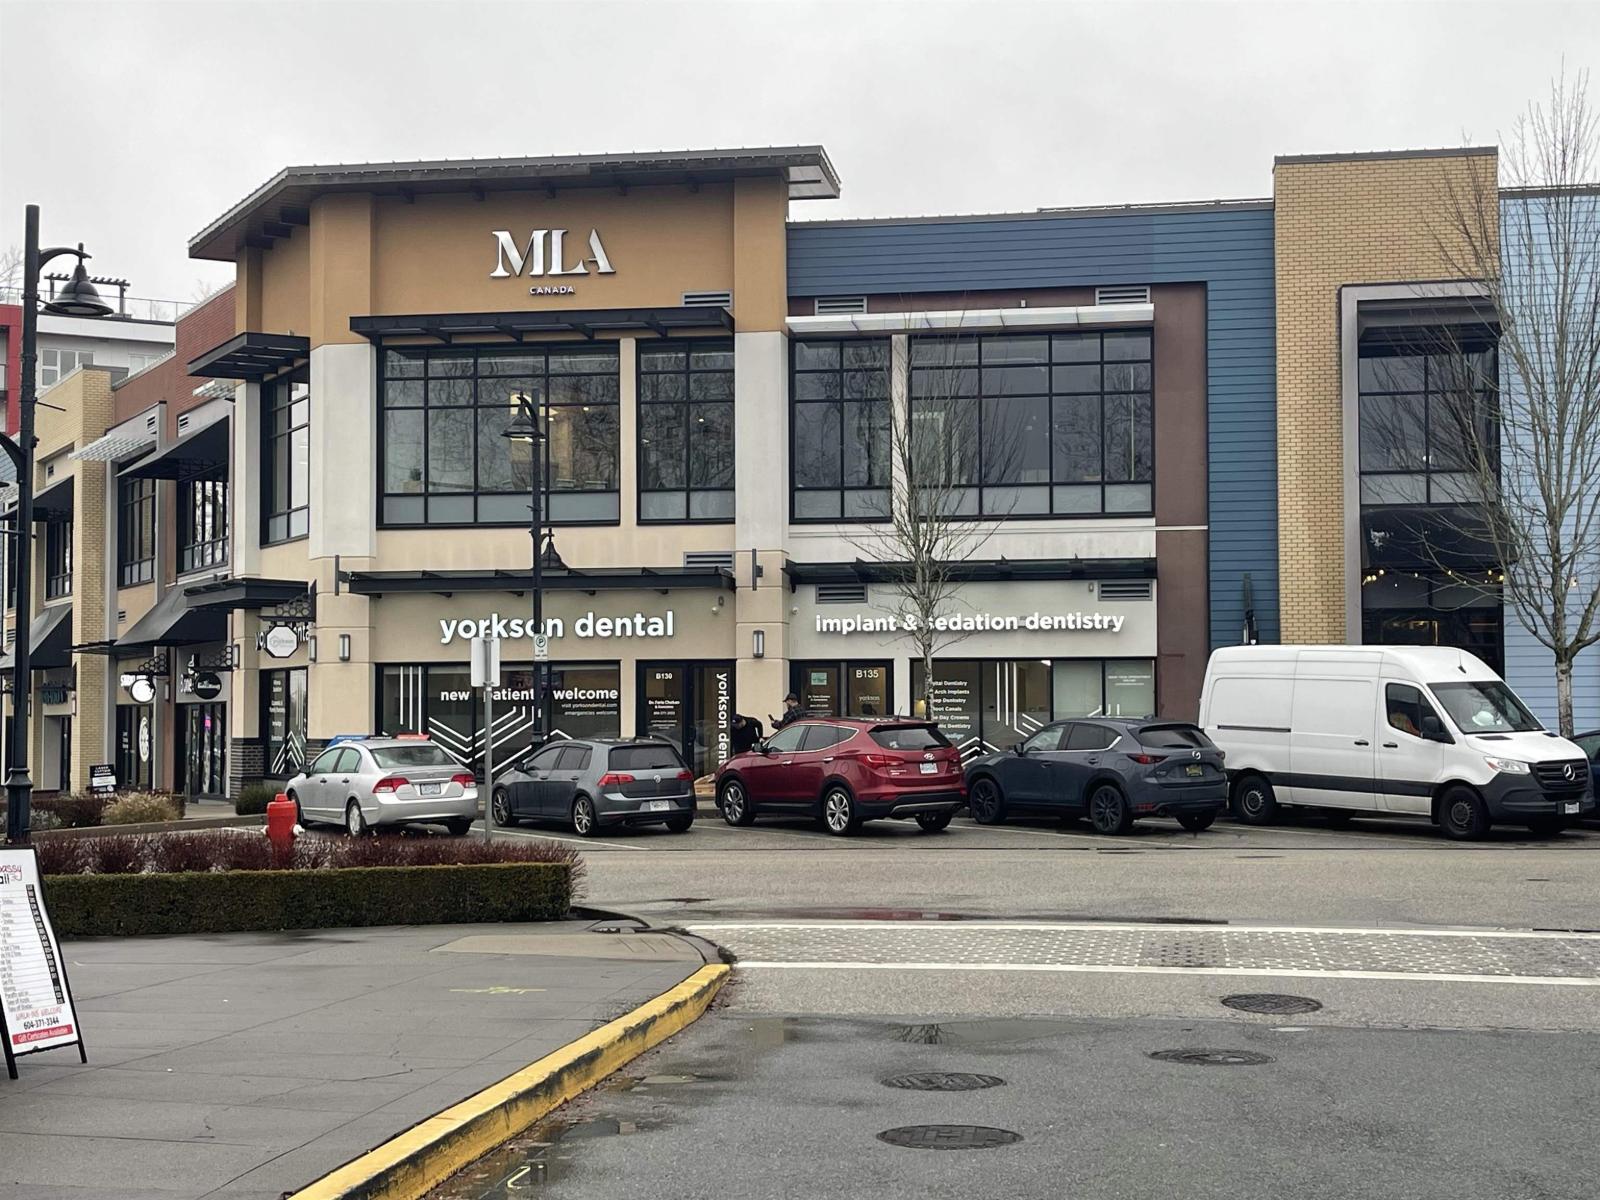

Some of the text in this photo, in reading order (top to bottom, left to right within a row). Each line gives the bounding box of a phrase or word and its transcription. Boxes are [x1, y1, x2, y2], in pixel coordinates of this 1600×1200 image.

[490, 228, 616, 277] MLA
[529, 286, 575, 295] CANADA
[439, 611, 674, 644] yorkson dental
[815, 613, 896, 634] implant
[903, 613, 918, 631] &
[1025, 611, 1124, 633] dentistry
[855, 669, 879, 679] B135
[440, 687, 618, 702] new atient welcome
[716, 673, 730, 765] yorkson dent
